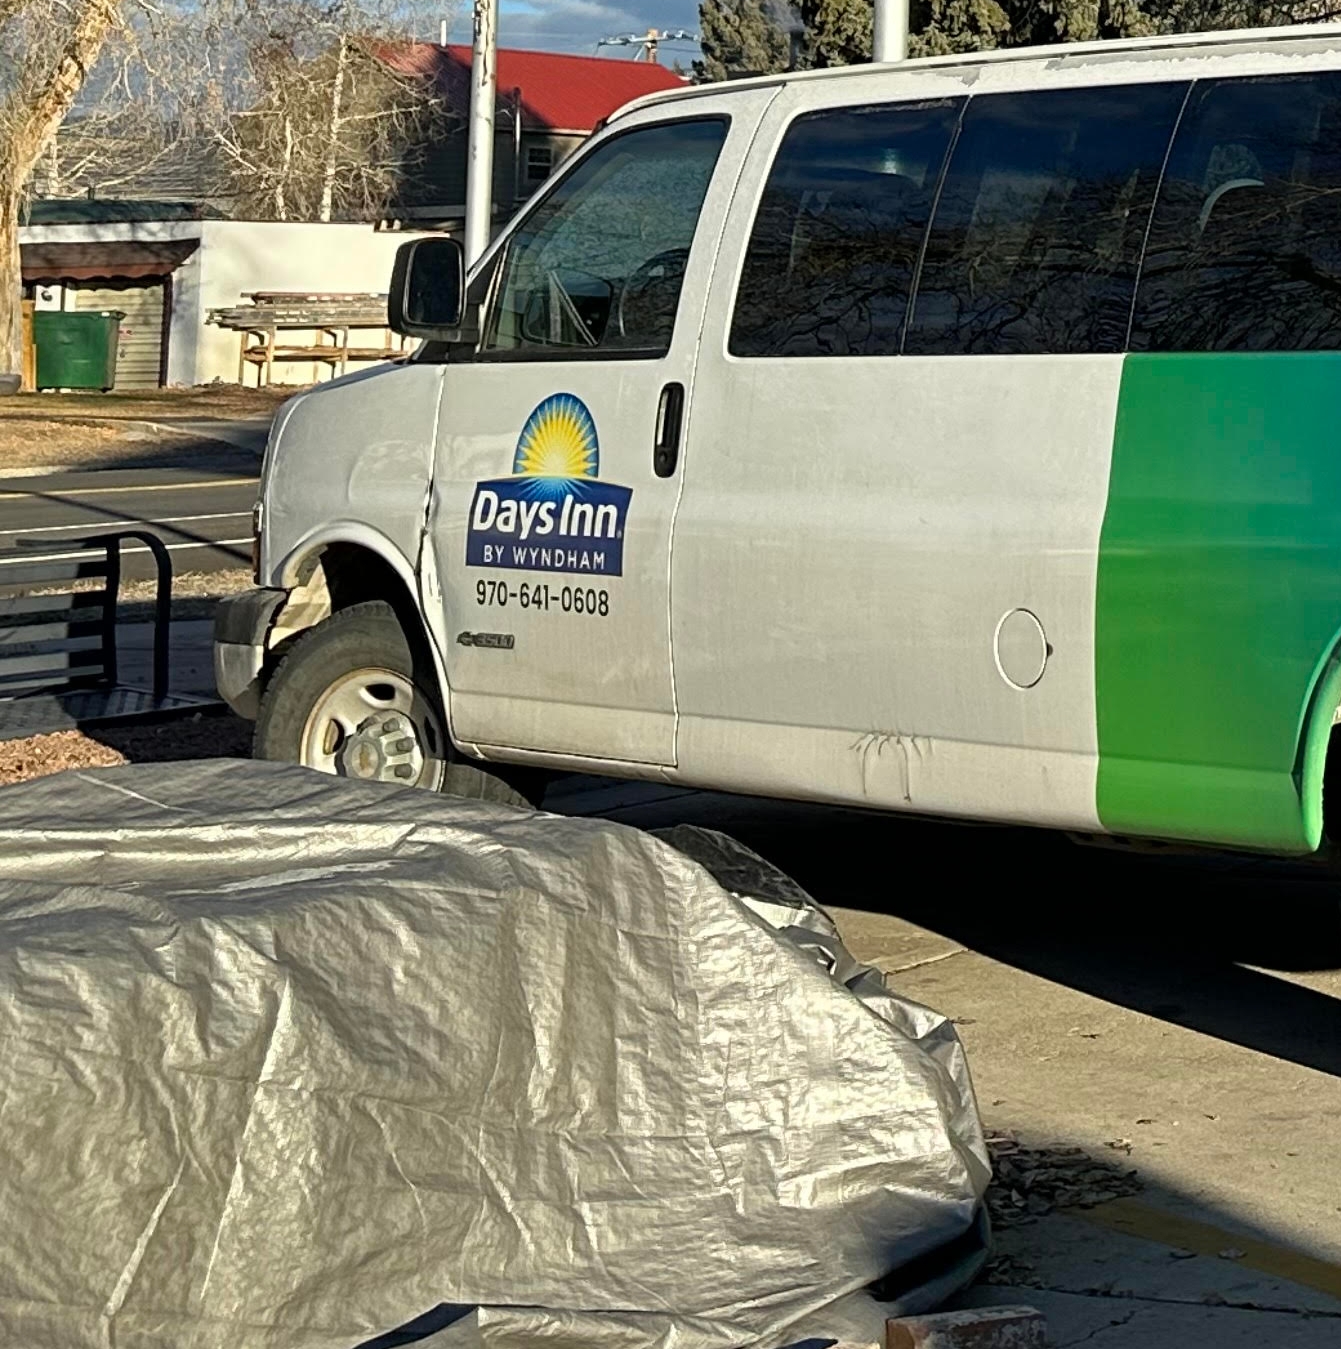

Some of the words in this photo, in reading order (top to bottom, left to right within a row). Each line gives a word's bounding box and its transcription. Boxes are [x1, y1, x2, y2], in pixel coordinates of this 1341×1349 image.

[472, 491, 556, 540] Days
[559, 494, 618, 538] Inn
[483, 545, 504, 562] BY
[513, 546, 604, 569] WYNDHAM
[476, 580, 609, 616] 970-641-0608
